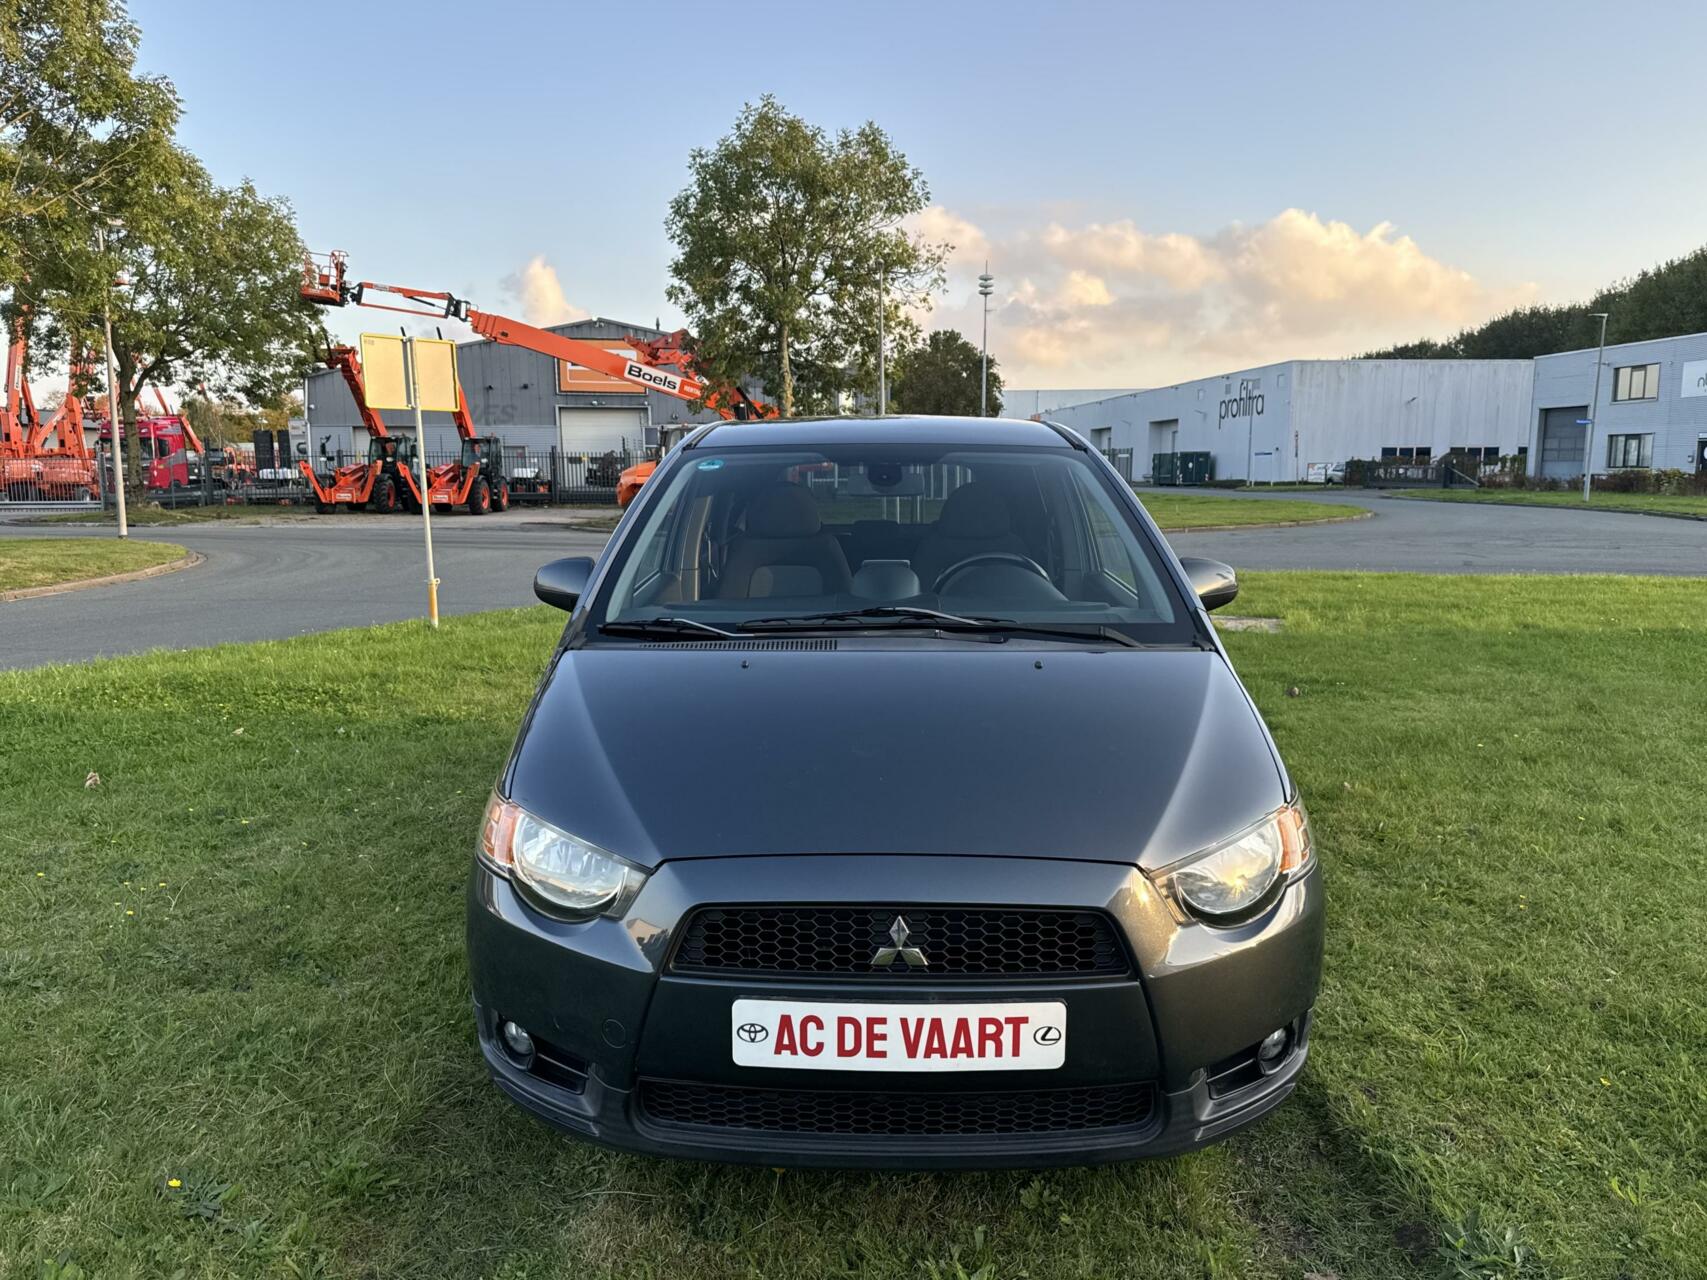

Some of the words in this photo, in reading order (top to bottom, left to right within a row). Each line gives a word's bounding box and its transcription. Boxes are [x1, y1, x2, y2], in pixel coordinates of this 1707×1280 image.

[627, 364, 677, 390] Boels
[1218, 380, 1265, 430] profiltra
[774, 1014, 824, 1056] AC
[836, 1016, 888, 1059] DE
[899, 1016, 1029, 1059] VAART
